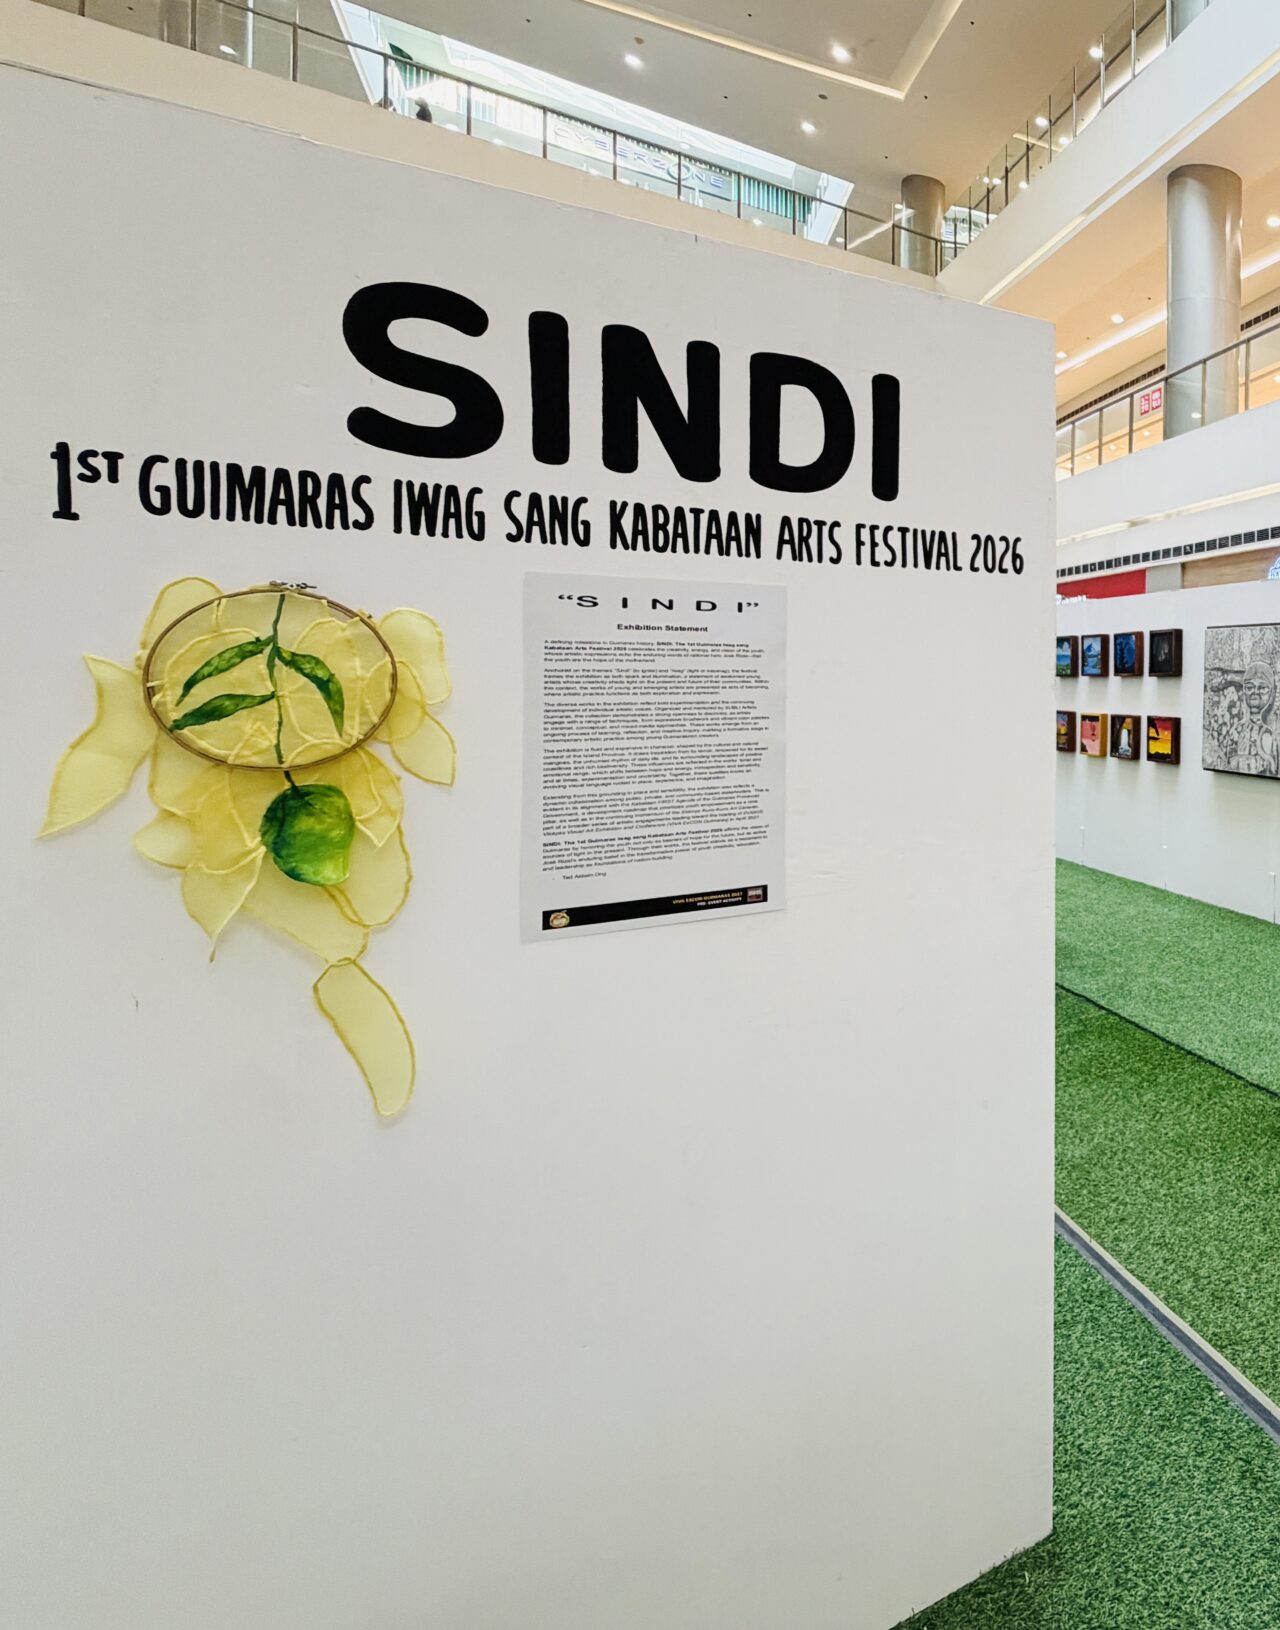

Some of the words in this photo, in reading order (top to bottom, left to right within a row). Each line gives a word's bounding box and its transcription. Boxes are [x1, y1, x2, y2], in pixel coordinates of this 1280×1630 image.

[342, 281, 900, 501] SINDI
[50, 442, 124, 520] 1ST
[139, 455, 374, 530] GUIMARAS
[392, 480, 485, 541] IWAG
[504, 490, 592, 547] SANG
[609, 501, 761, 559] KABATAAN
[777, 516, 841, 564] ARTS
[856, 523, 962, 571] FESTIVAL
[970, 534, 1024, 575] 2026
[617, 624, 663, 632] Exhibition
[665, 625, 708, 633] Statement
